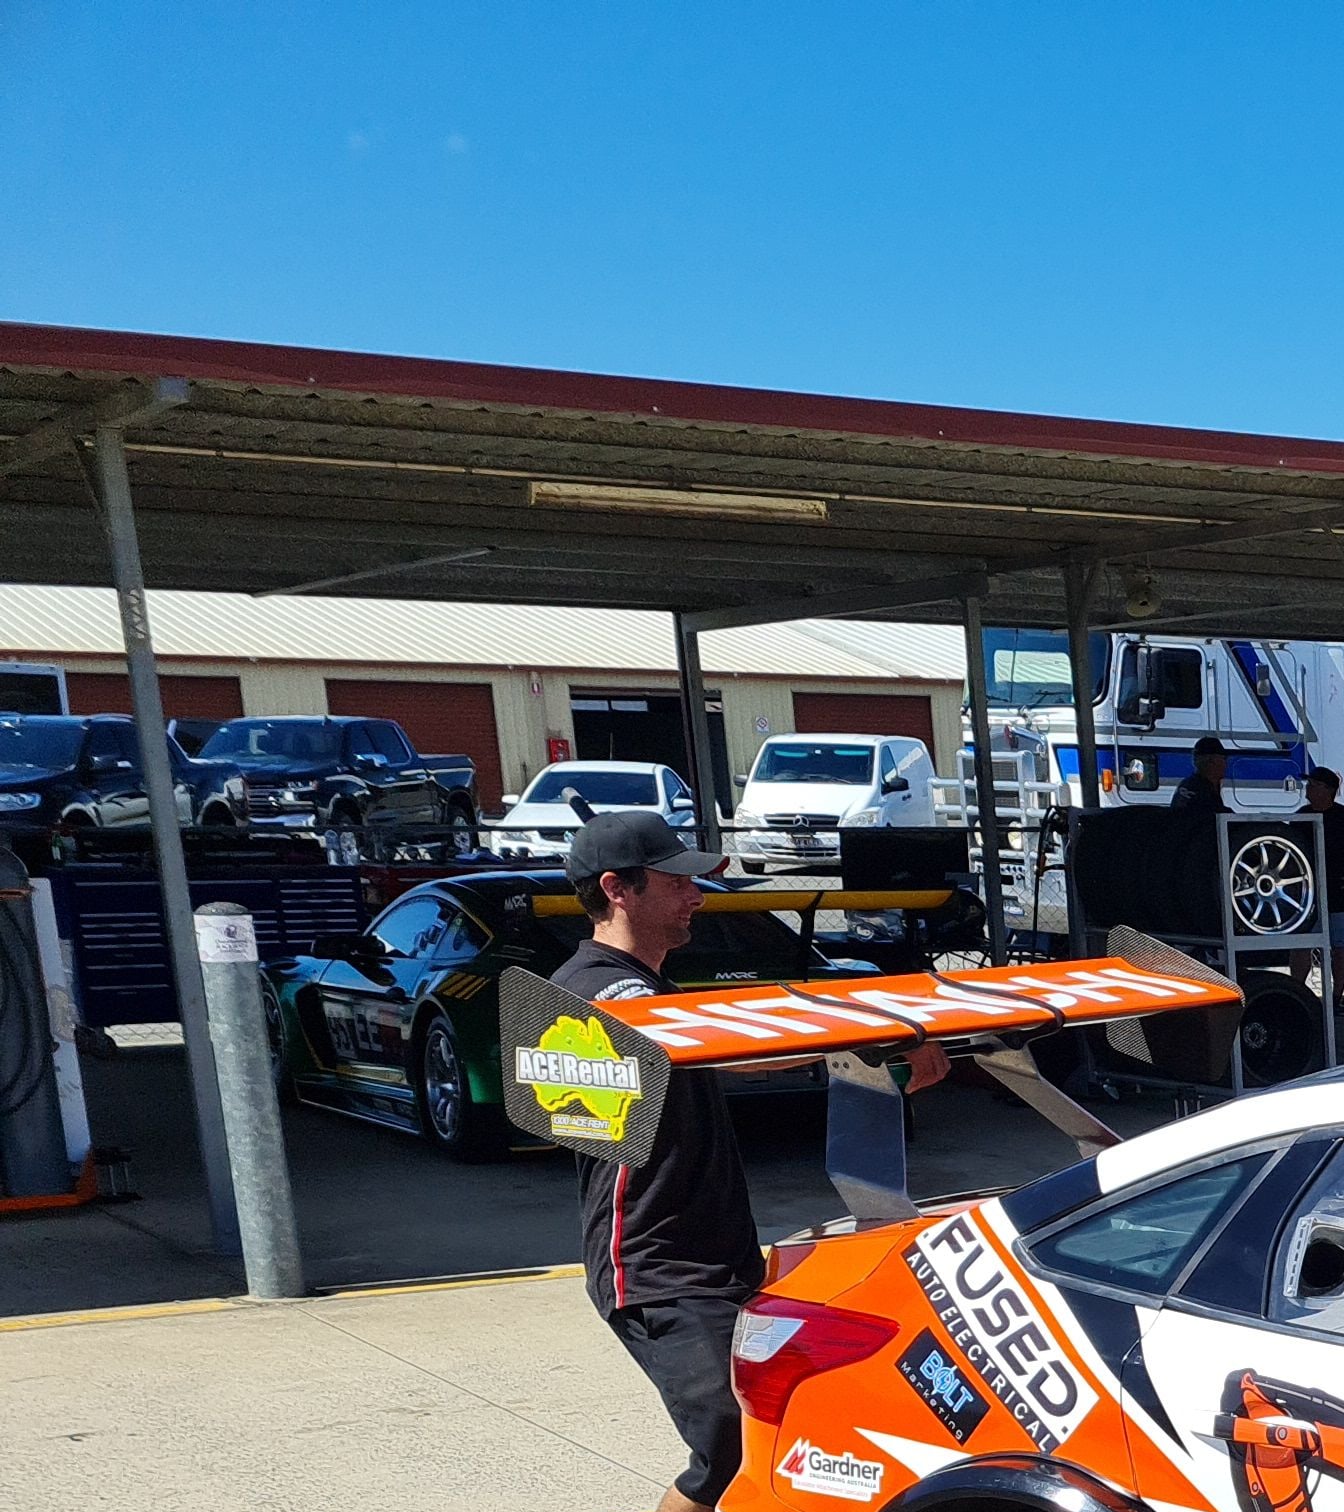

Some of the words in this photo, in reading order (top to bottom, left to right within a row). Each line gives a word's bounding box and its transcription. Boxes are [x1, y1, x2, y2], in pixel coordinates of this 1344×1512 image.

[633, 968, 1207, 1048] HITACHI
[715, 971, 759, 981] MARC
[519, 1050, 561, 1083] ACE
[562, 1053, 638, 1090] Rental
[906, 1252, 947, 1301] AUTO
[929, 1215, 1078, 1418] FUSED
[900, 1361, 963, 1440] Marketing
[919, 1349, 974, 1413] BOLT
[940, 1306, 1054, 1452] ELECTRICAL
[809, 1450, 881, 1481] Gardner
